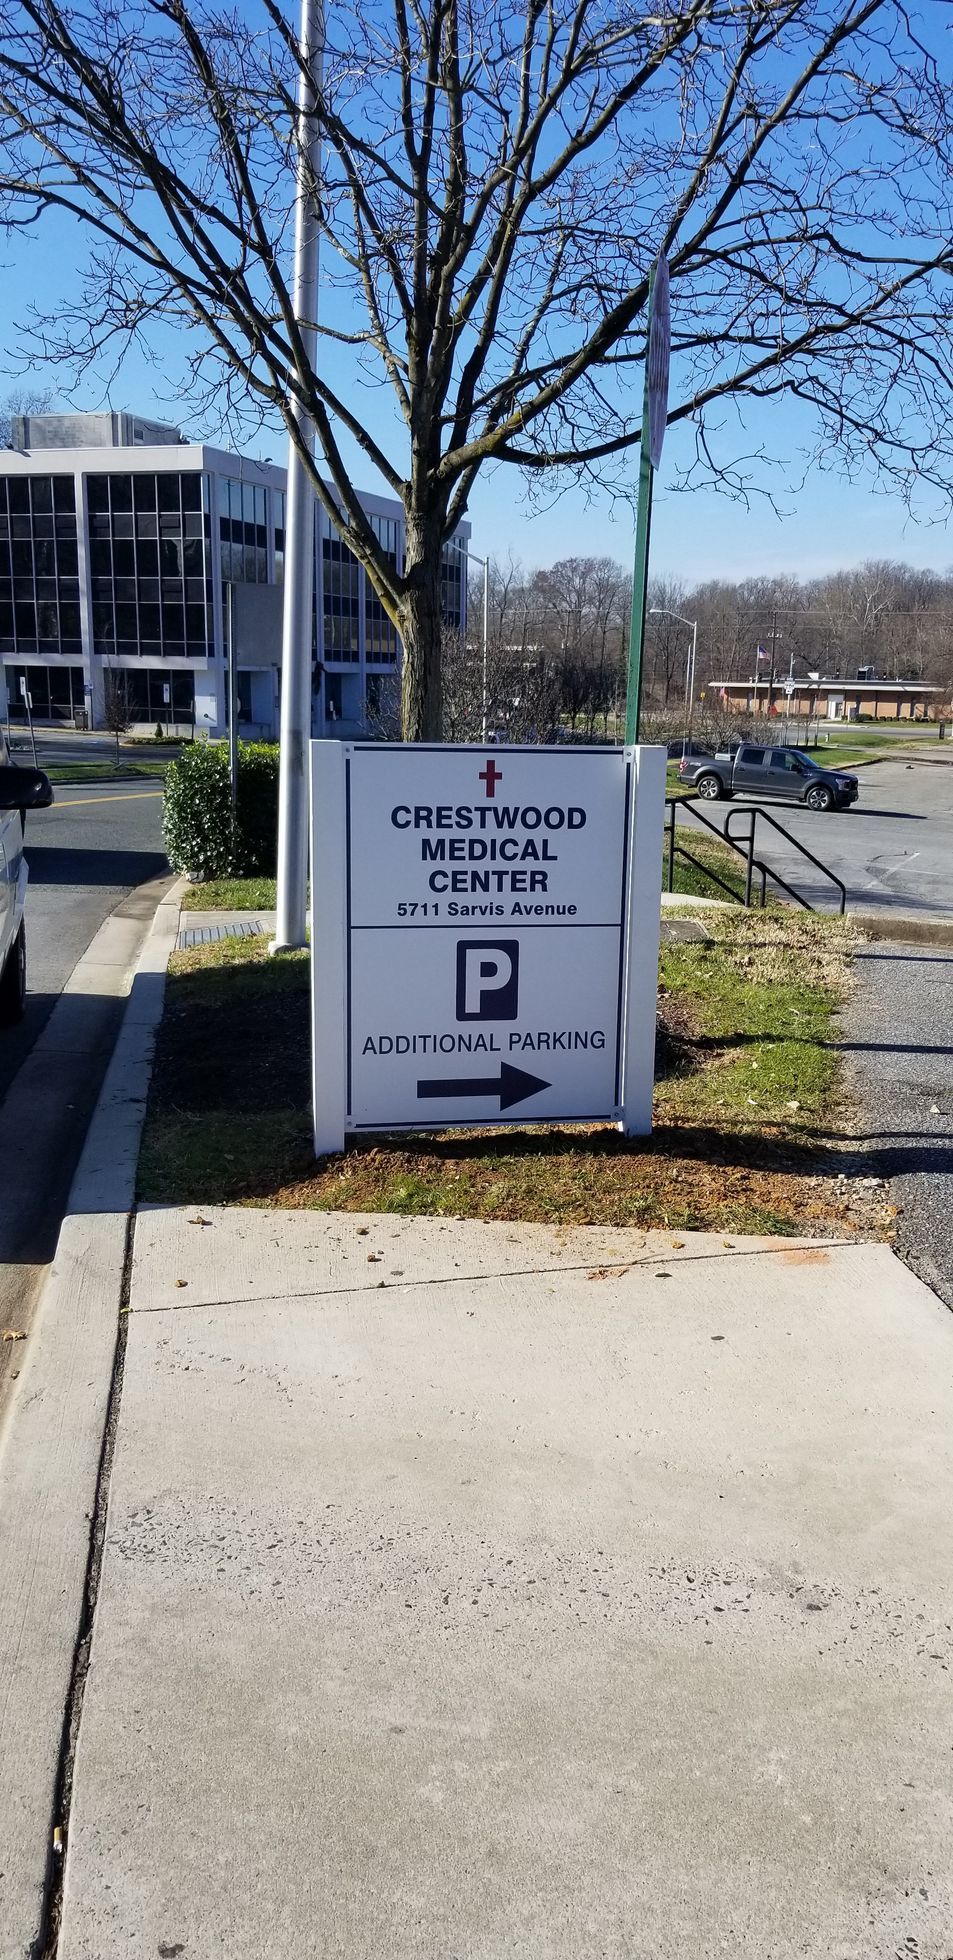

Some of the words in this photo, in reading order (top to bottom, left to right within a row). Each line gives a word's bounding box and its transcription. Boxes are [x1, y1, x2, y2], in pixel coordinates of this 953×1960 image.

[390, 805, 587, 830] CRESTWOOD
[421, 838, 558, 862] MEDICAL
[428, 870, 548, 893] CENTER
[397, 902, 439, 917] 5711
[447, 902, 505, 916] Sarvis
[510, 901, 578, 916] Avenue
[464, 948, 512, 1014] P
[362, 1032, 501, 1056] ADDITIONAL
[508, 1030, 606, 1051] PARKING
